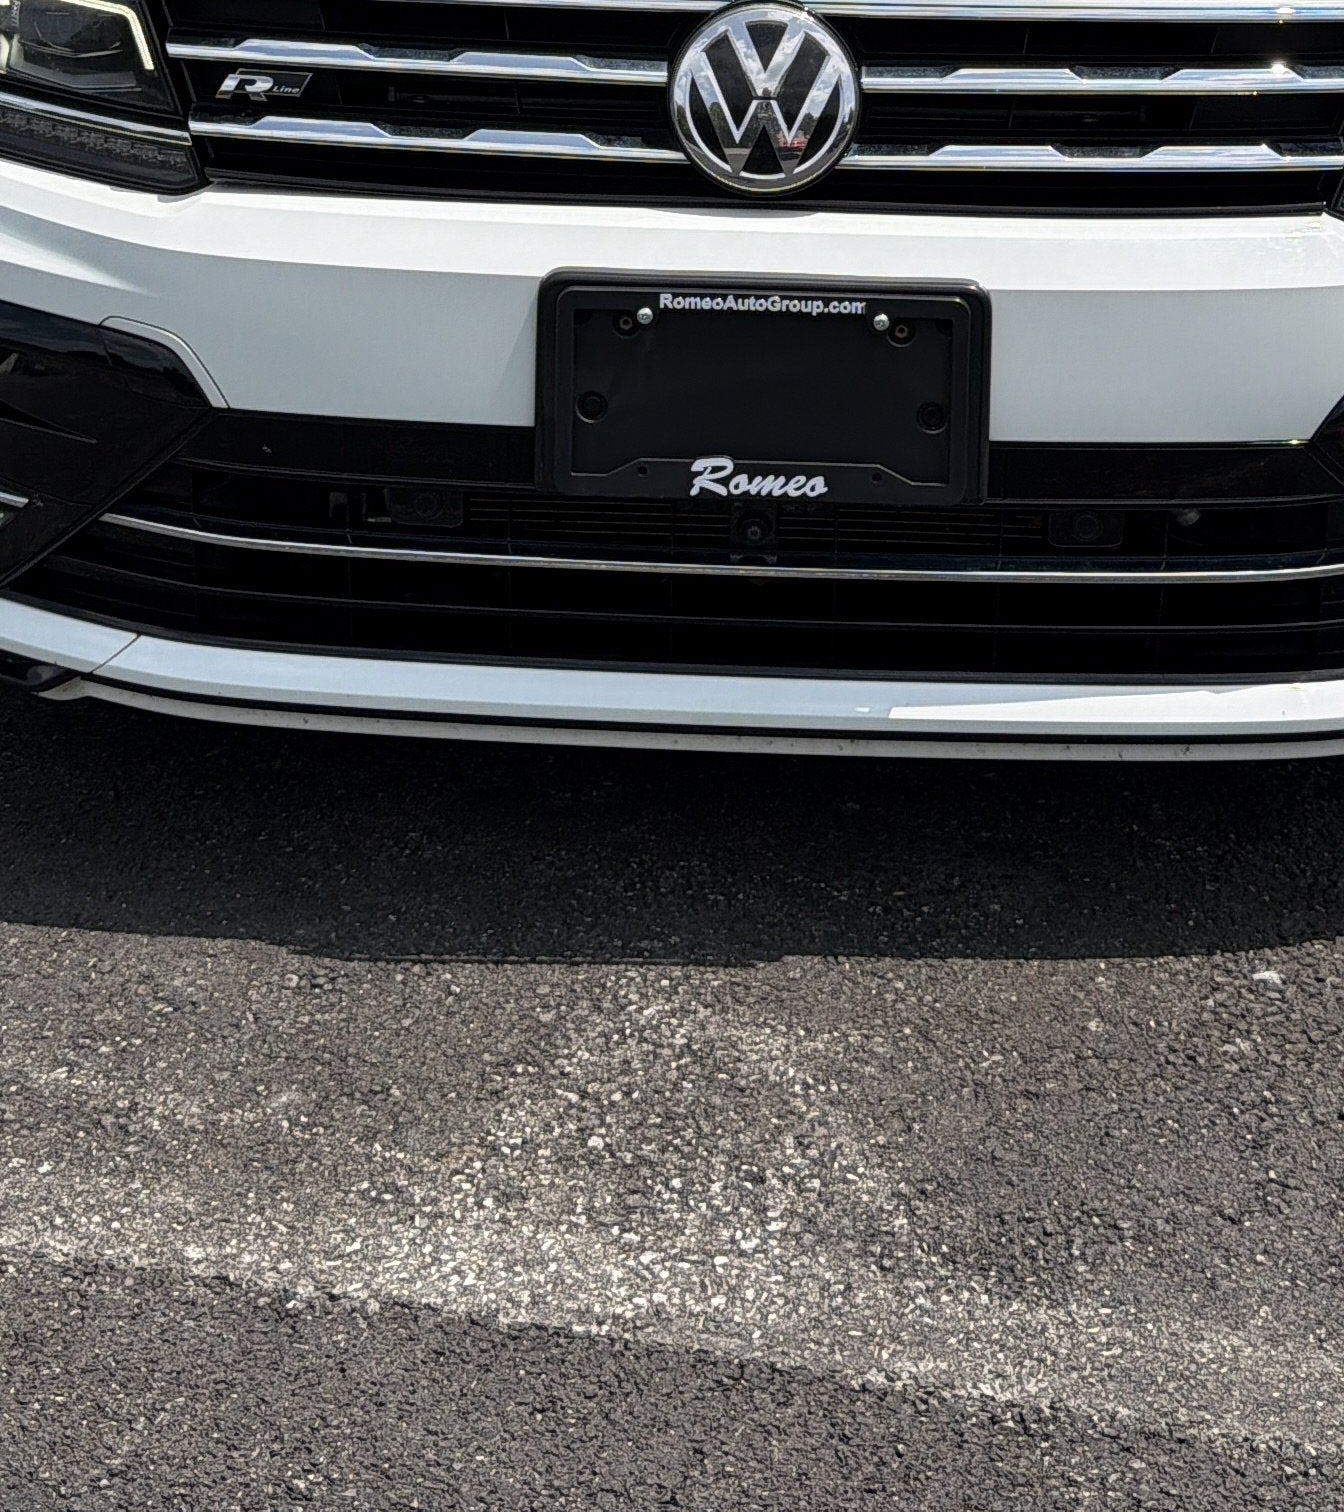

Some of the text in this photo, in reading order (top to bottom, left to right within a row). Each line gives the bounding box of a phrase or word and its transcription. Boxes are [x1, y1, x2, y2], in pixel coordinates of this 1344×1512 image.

[272, 85, 300, 94] Line
[659, 293, 866, 316] RomeoAutoGroup.com
[689, 457, 828, 497] Romeo
